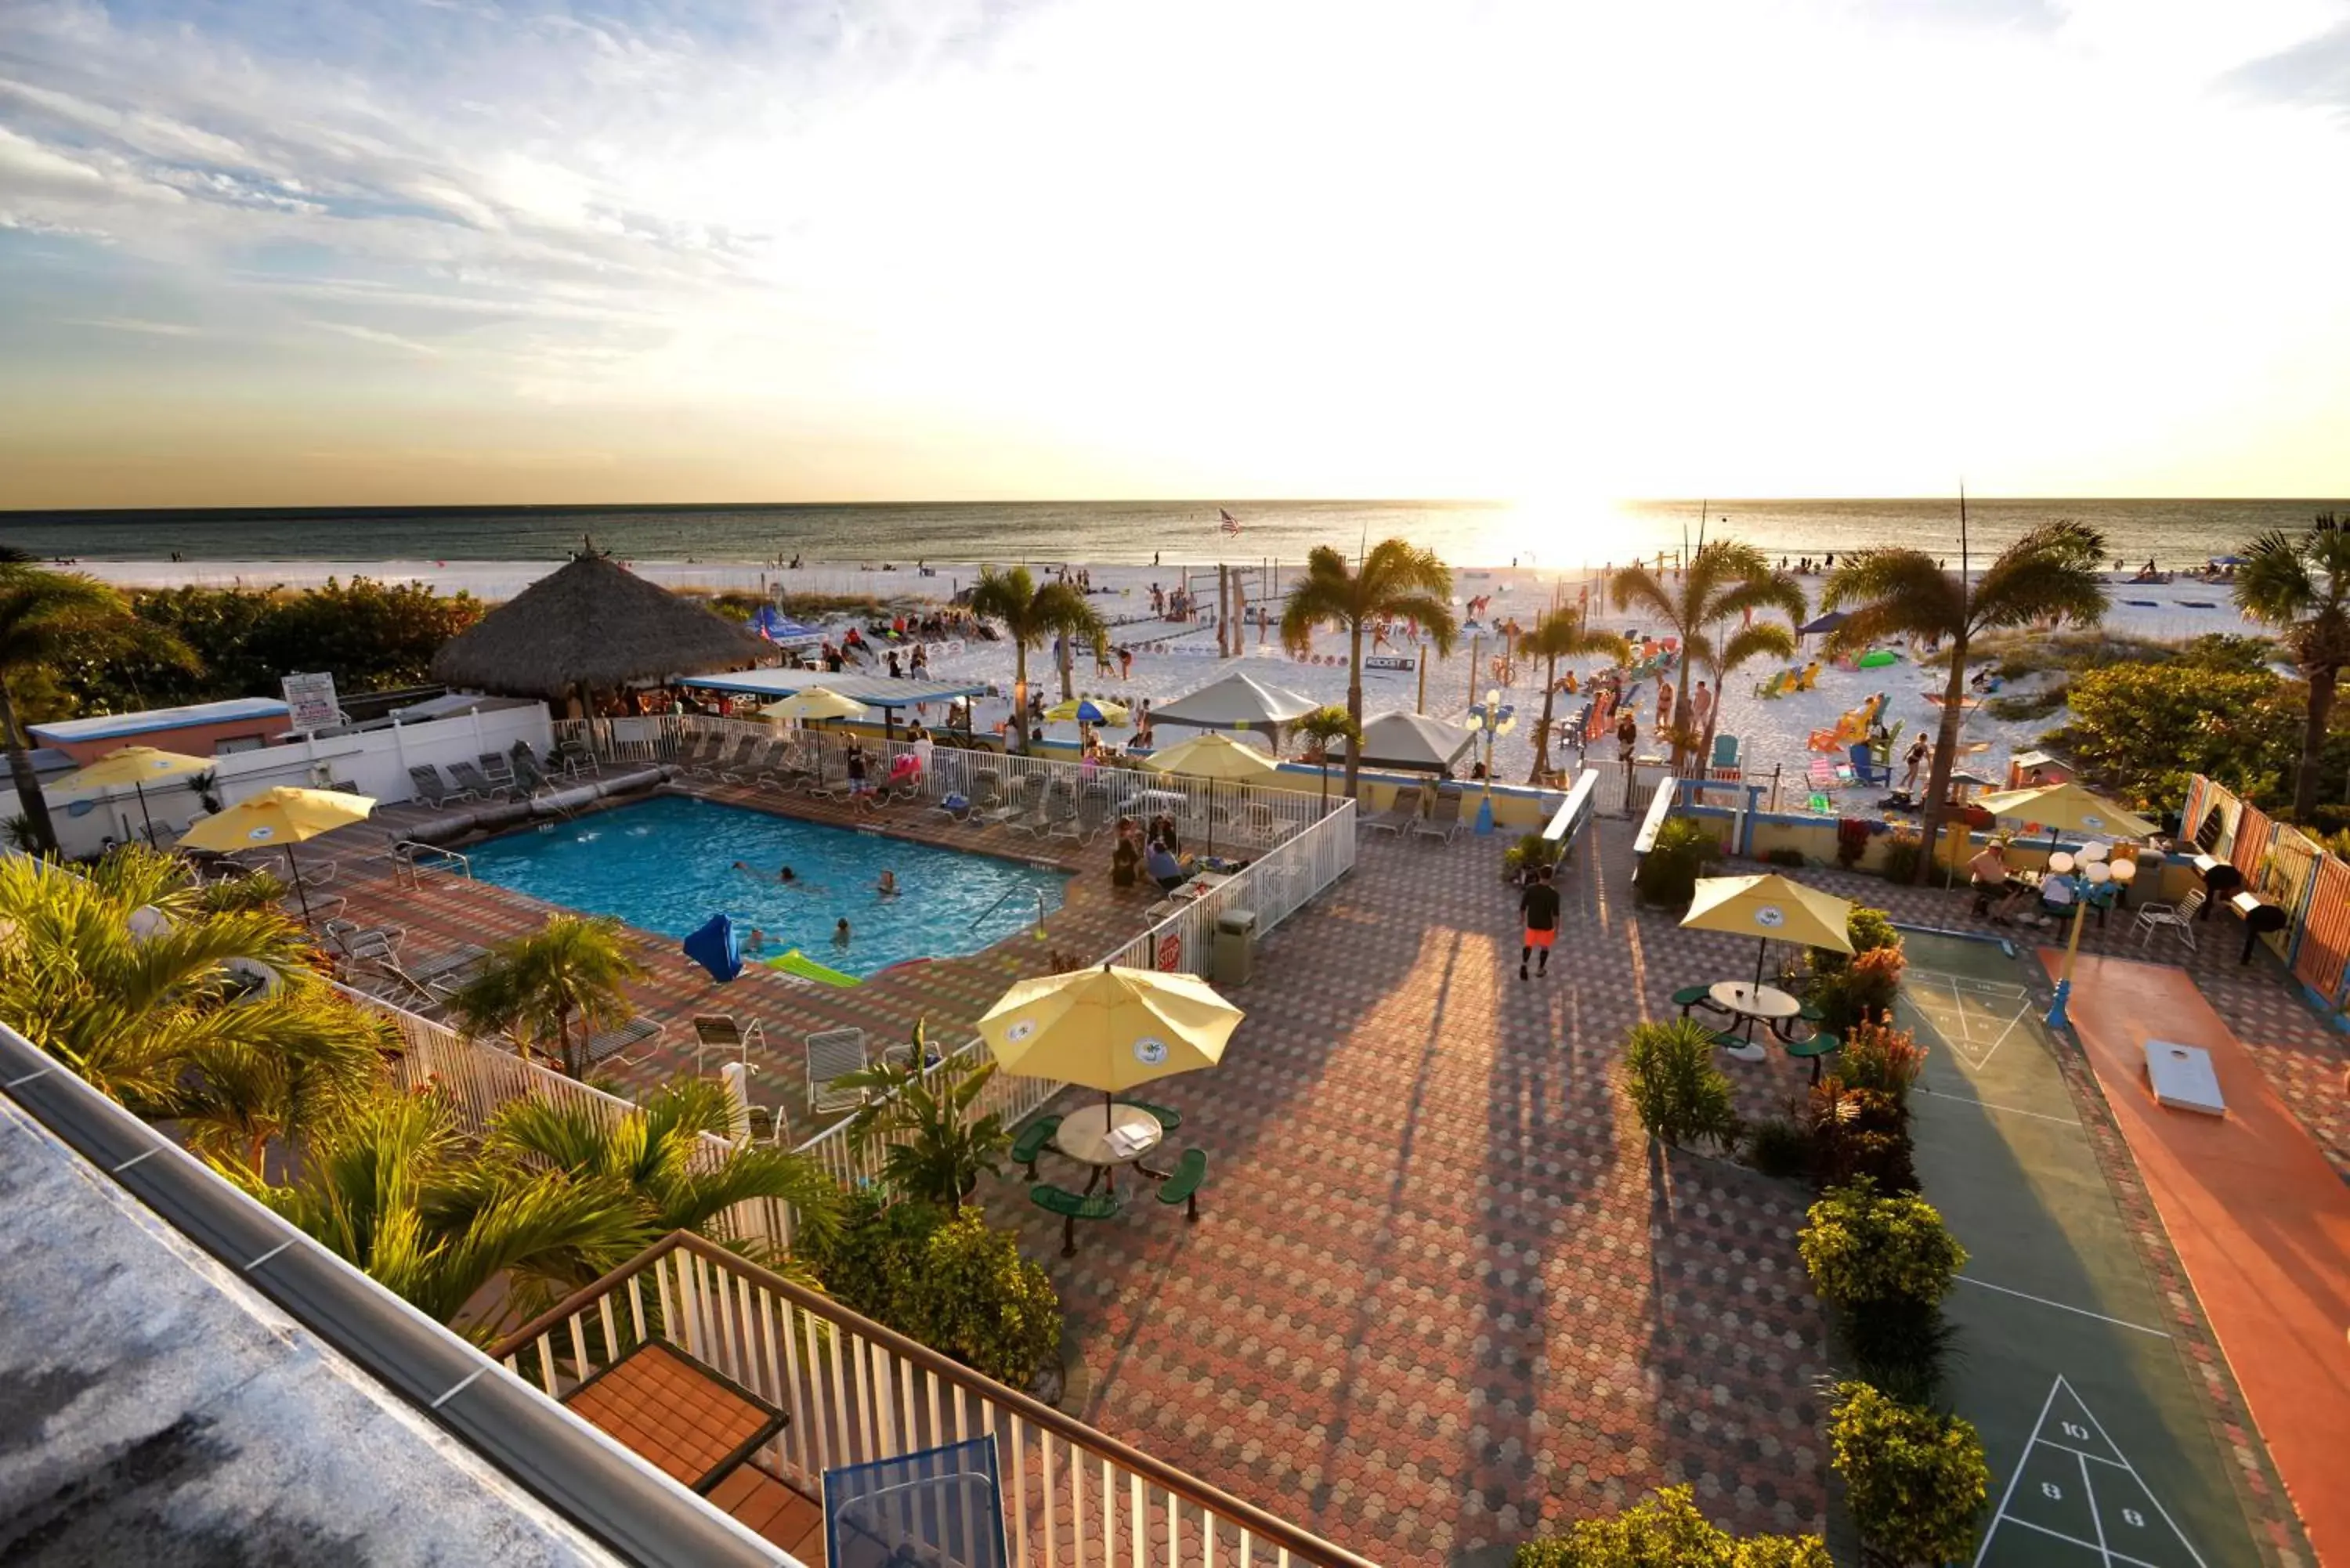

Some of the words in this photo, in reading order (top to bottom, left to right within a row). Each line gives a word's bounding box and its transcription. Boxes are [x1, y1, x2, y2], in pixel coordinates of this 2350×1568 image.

[1159, 943, 1178, 965] STOP
[2062, 1422, 2089, 1440] 10
[2041, 1483, 2062, 1500] 8
